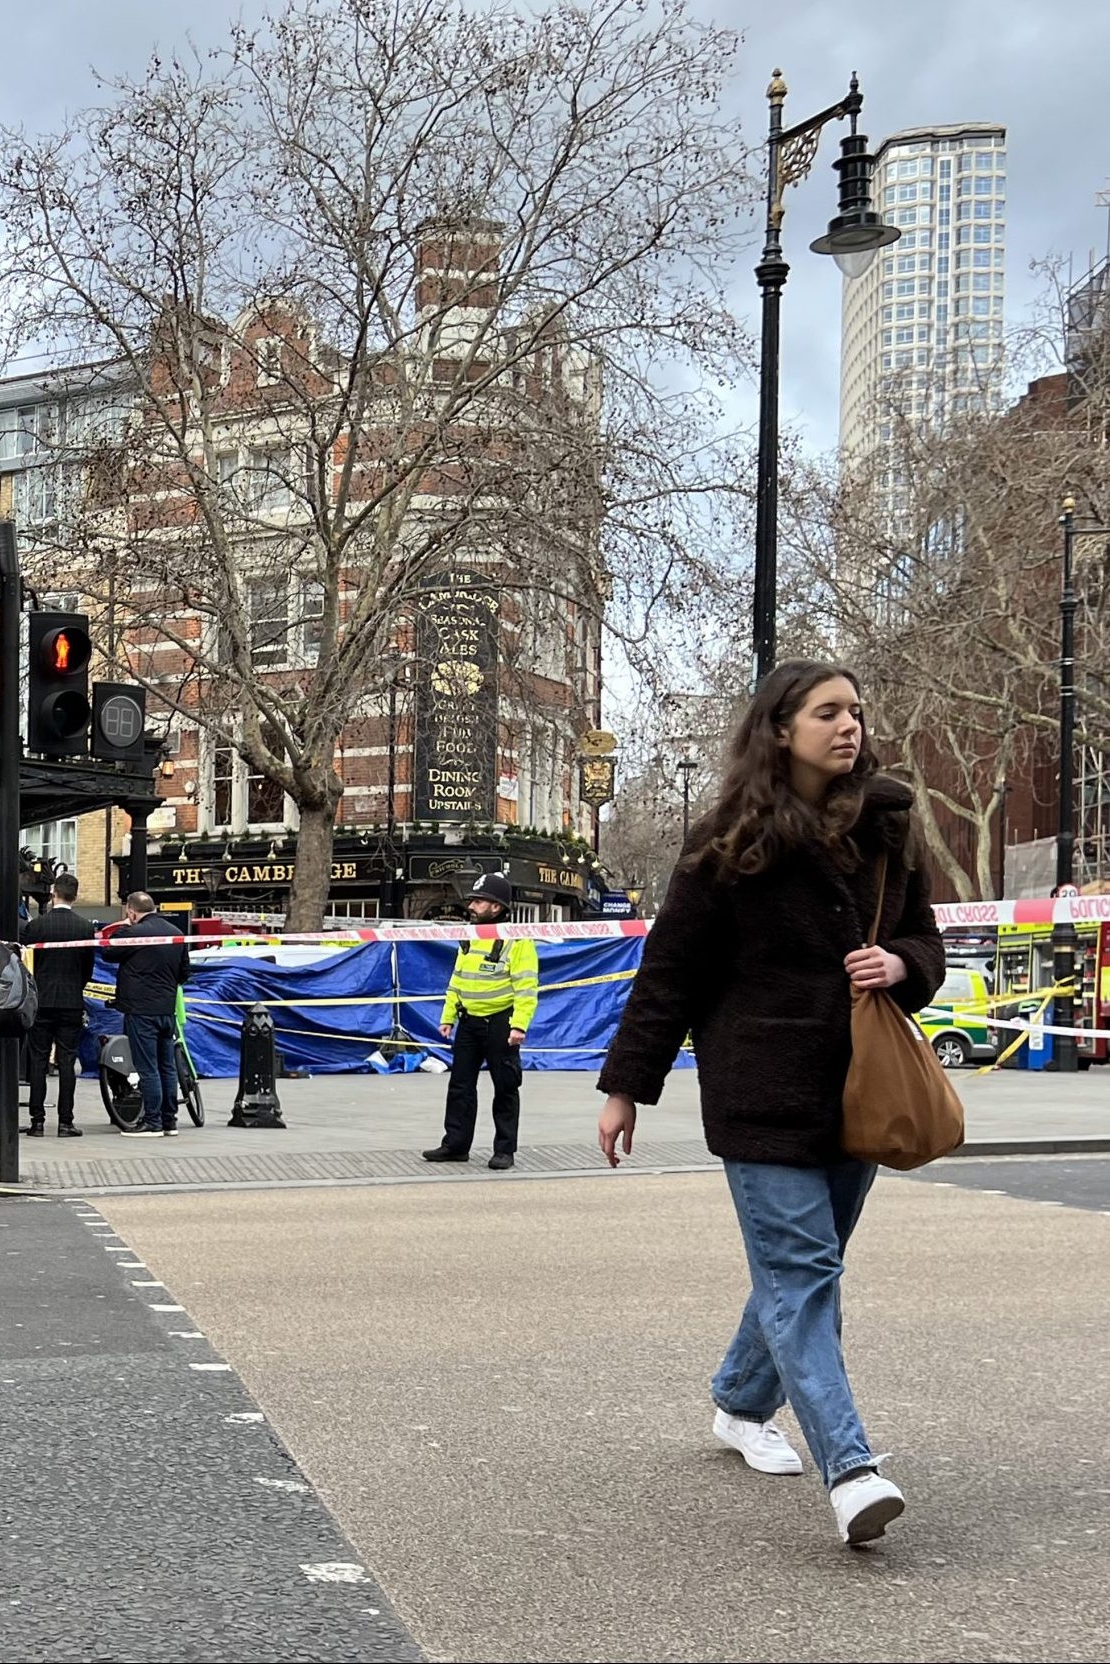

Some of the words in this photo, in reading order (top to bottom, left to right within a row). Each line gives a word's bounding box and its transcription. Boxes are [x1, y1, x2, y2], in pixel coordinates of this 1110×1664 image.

[439, 627, 479, 640] CASK
[439, 642, 477, 655] ALES
[428, 768, 482, 782] DINING
[433, 783, 477, 798] ROOM
[538, 867, 556, 884] THE
